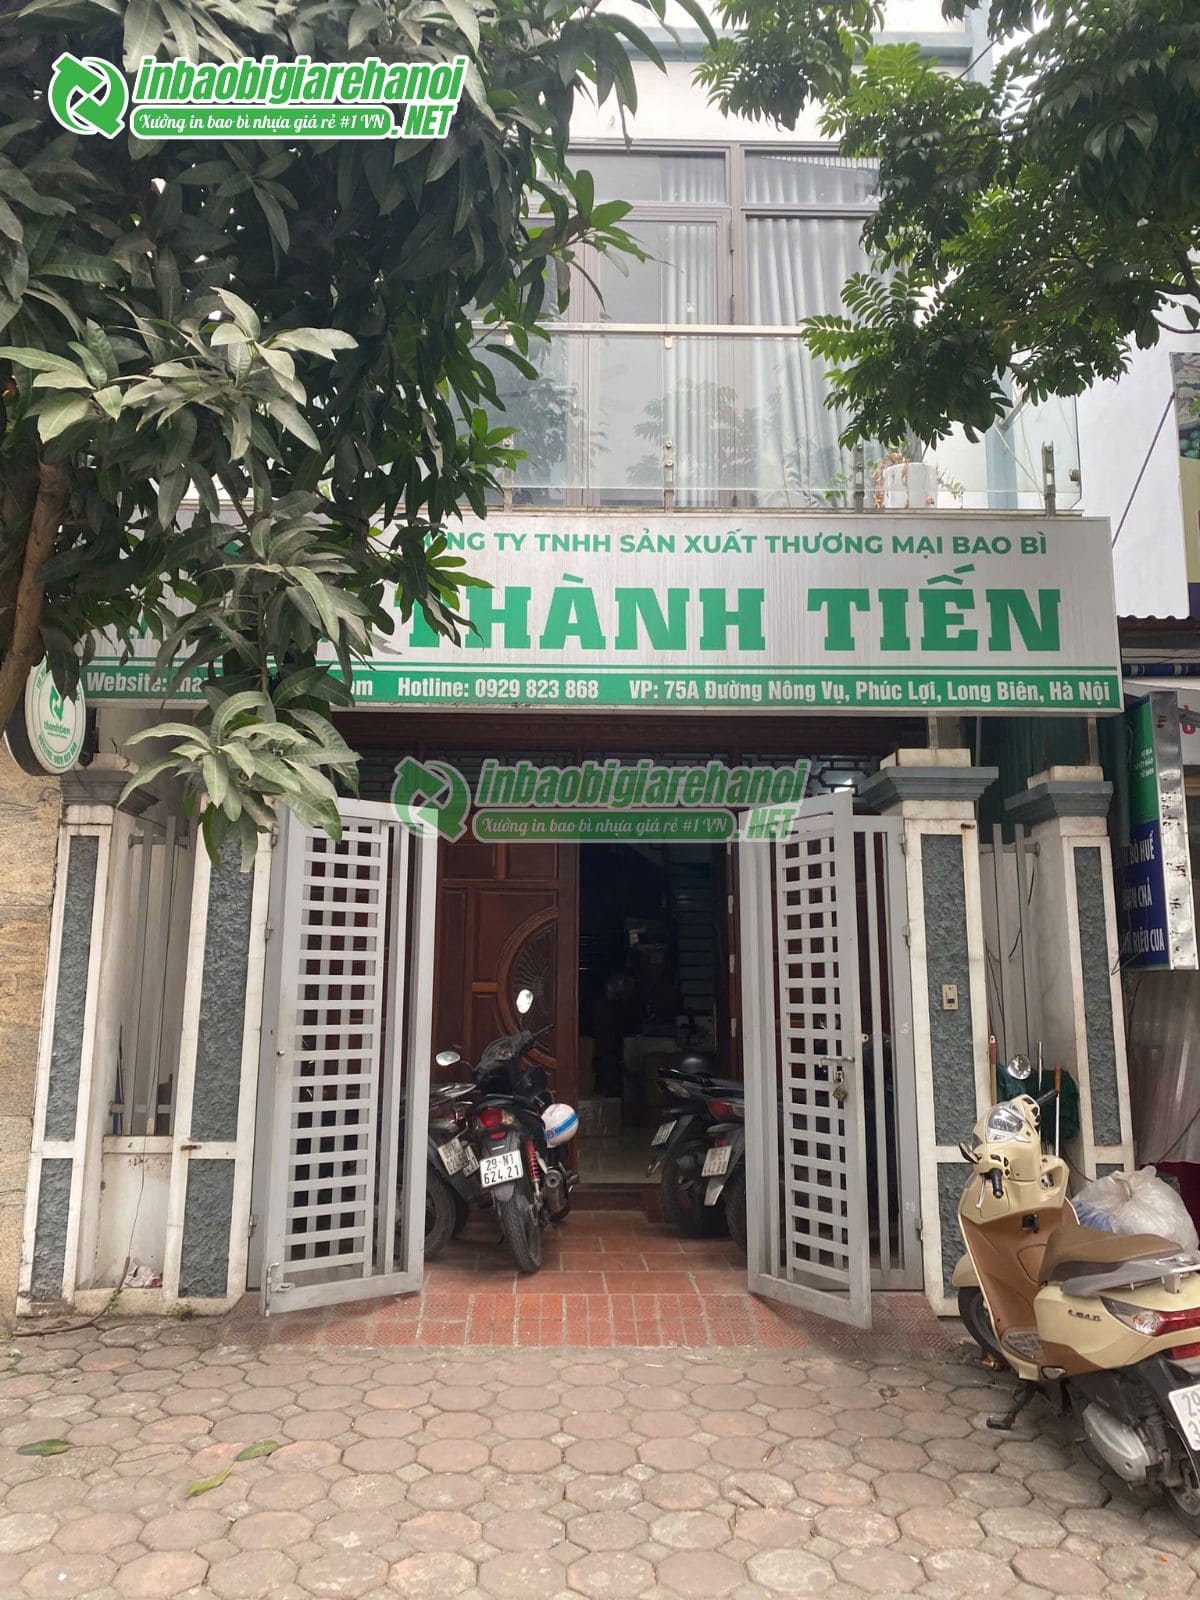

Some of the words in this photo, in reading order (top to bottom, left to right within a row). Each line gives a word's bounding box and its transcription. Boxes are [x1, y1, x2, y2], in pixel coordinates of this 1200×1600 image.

[494, 532, 527, 551] TY
[534, 533, 611, 553] TNHH
[619, 528, 676, 554] SẢN
[684, 528, 757, 554] XUẤT
[764, 532, 883, 554] THƯƠNG
[891, 535, 943, 559] MẠI
[952, 535, 1012, 554] BAO
[1020, 531, 1047, 554] BÌ
[807, 563, 1061, 652] TIẾN
[397, 677, 469, 698] Hotline:
[475, 678, 520, 699] 0929
[525, 679, 559, 699] 823
[565, 680, 599, 700] 868
[629, 680, 659, 700] VP:
[664, 680, 700, 700] 75A
[704, 681, 762, 703] Đường
[768, 681, 816, 703] Nông
[821, 681, 850, 704] Vụ,
[855, 681, 902, 701] Phúc
[907, 681, 942, 705] Lợi,
[947, 681, 991, 703] Long
[997, 681, 1045, 704] Biên,
[1049, 682, 1074, 702] Hà
[1079, 682, 1110, 705] Nội
[1150, 928, 1165, 952] CUA
